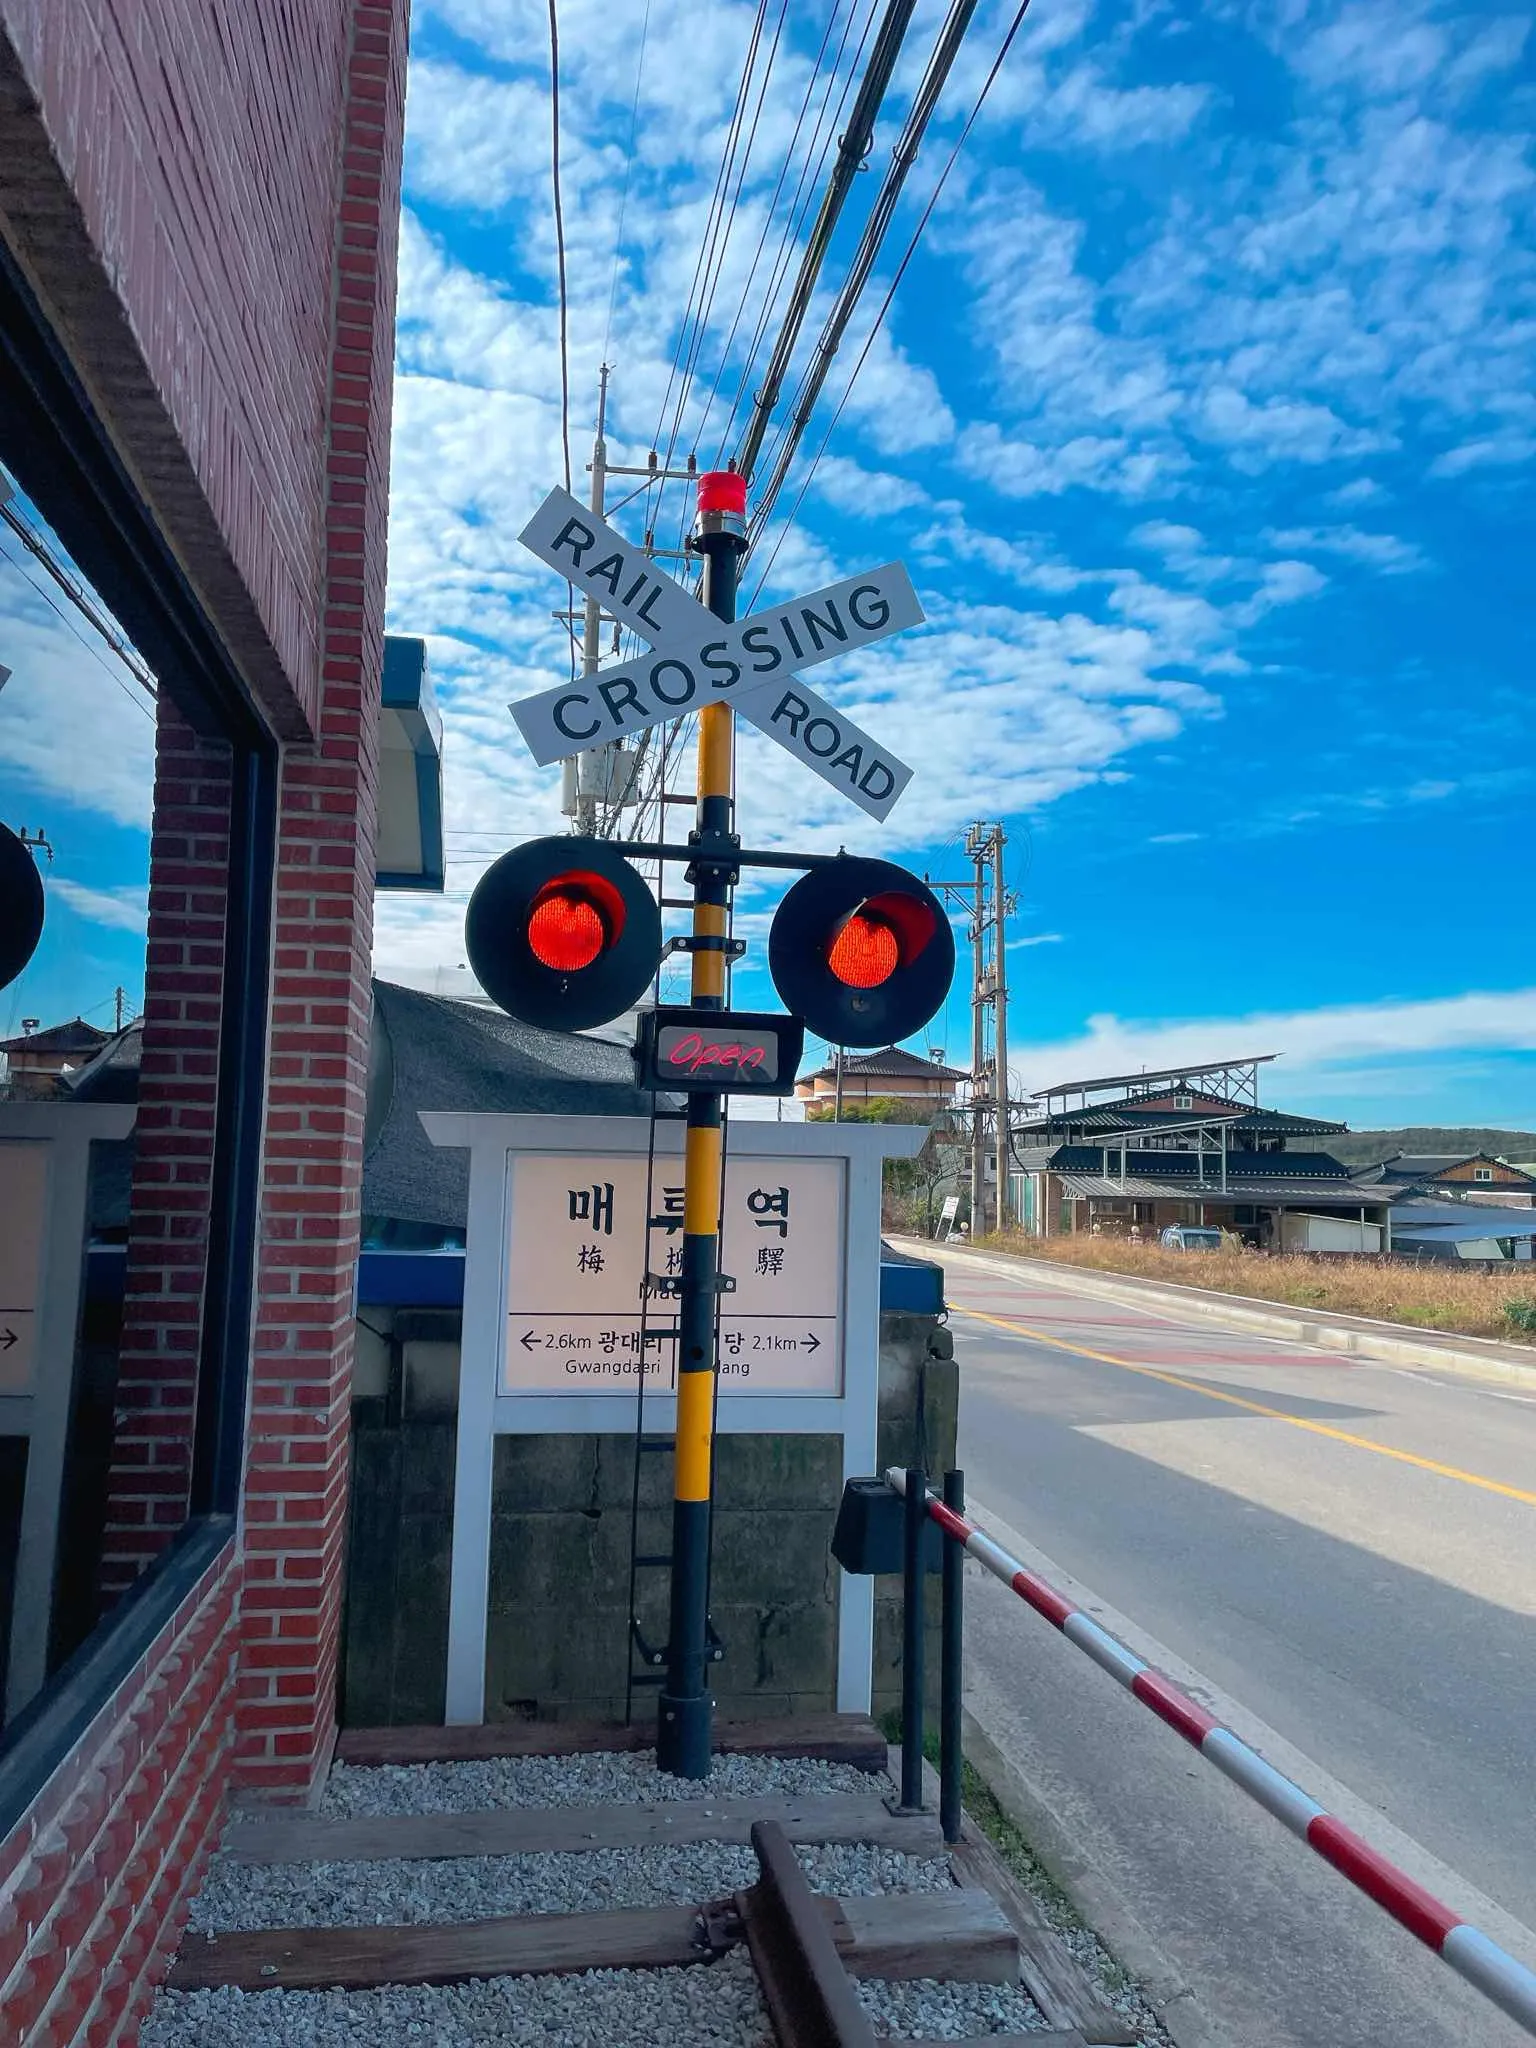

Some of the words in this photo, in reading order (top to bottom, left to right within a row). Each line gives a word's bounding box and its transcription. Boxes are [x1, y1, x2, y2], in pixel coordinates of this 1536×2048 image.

[551, 517, 662, 632] RAIL
[770, 691, 896, 800] ROAD
[552, 585, 890, 740] CROSSING
[668, 1032, 767, 1073] Open
[544, 1333, 592, 1349] 2.6km
[723, 1331, 746, 1355] 당
[752, 1335, 797, 1350] 2.1km
[565, 1359, 661, 1376] Gwangdaeri
